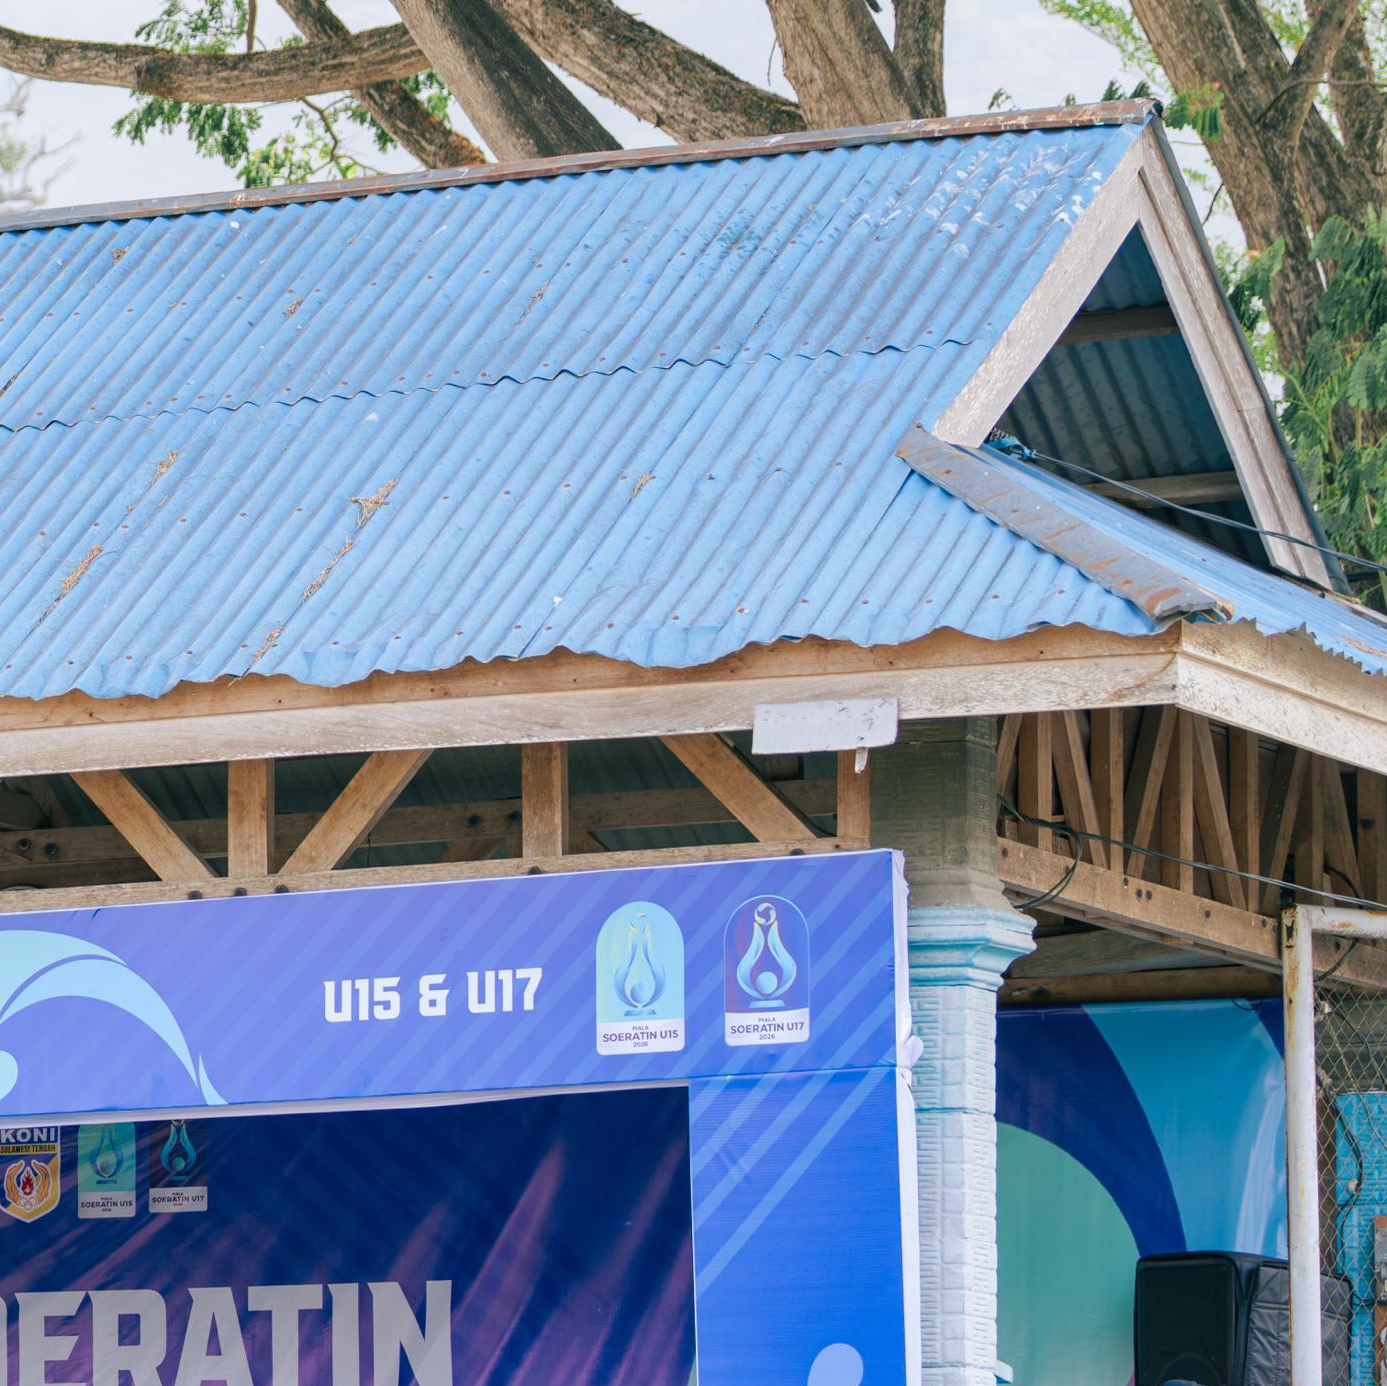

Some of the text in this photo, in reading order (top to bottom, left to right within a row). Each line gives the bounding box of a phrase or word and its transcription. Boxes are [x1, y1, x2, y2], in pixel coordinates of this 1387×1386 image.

[324, 967, 543, 1023] U15 & U17
[730, 1021, 805, 1034] SOERATIN U17
[602, 1030, 679, 1043] SOERATIN U15
[0, 1128, 55, 1144] KONI
[0, 1144, 56, 1154] SULAWESI TENGAH
[80, 1200, 133, 1209] SOERATIN U15
[152, 1194, 205, 1203] SOERATIN U17
